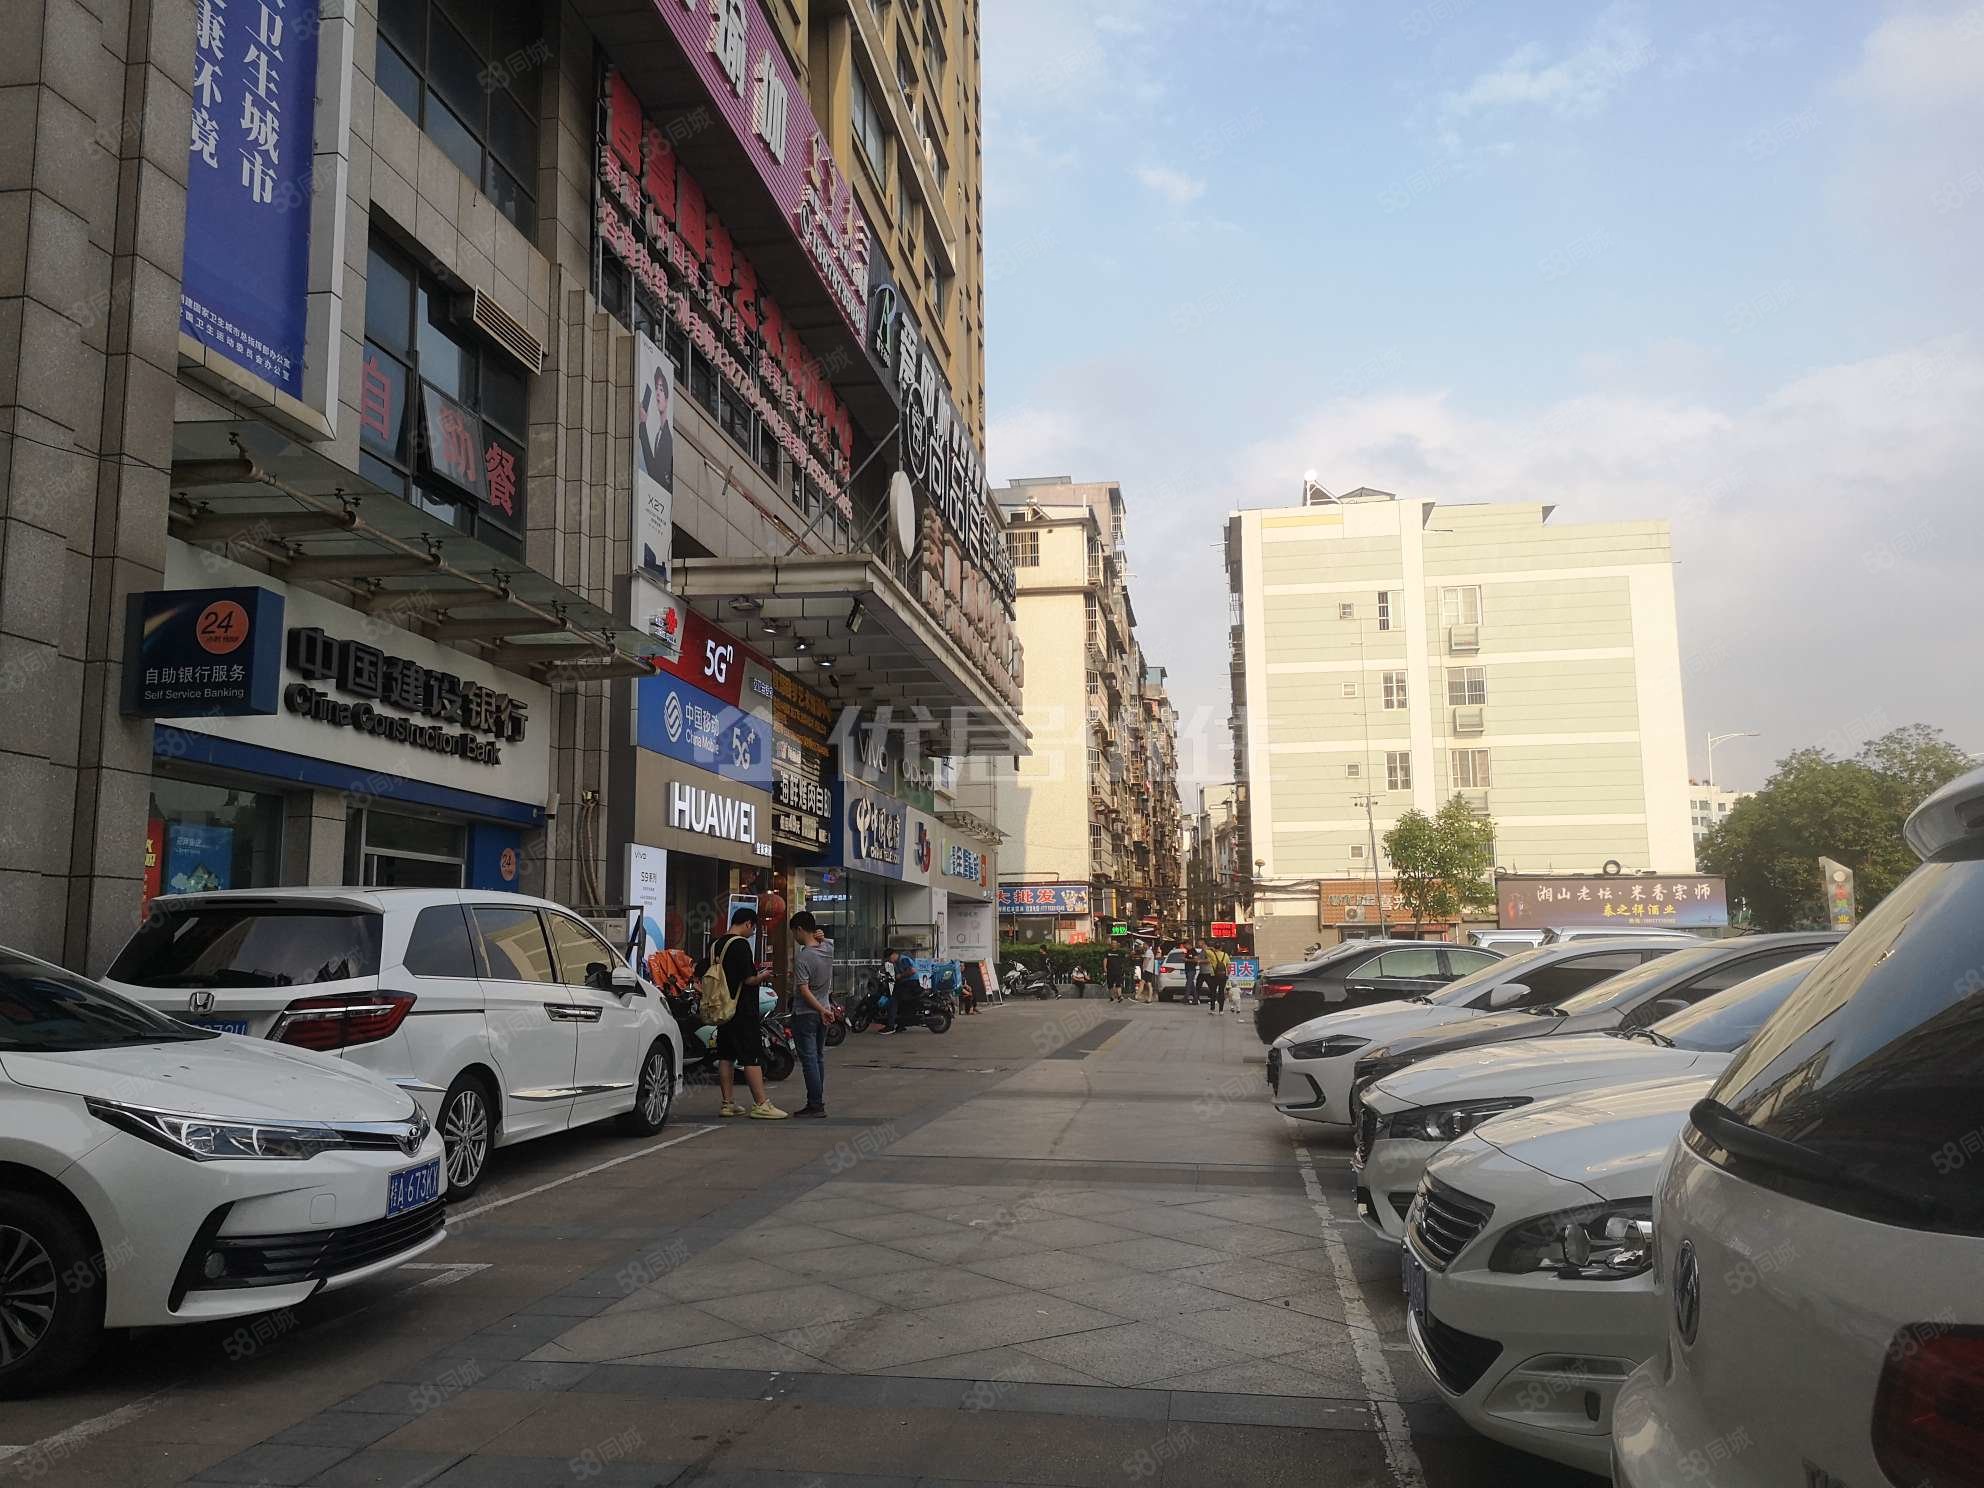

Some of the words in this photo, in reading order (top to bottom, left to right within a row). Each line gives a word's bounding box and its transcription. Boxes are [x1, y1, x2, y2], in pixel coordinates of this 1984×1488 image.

[240, 0, 287, 204] 卫生城市
[684, 0, 788, 166] 瑜伽
[200, 610, 234, 634] 24
[144, 663, 246, 685] 自助银行服务
[144, 689, 164, 700] Self
[165, 687, 202, 700] Service
[204, 686, 245, 700] Banking
[290, 627, 529, 742] 中国建设银行
[284, 682, 352, 727] China
[351, 701, 461, 756] Construction
[460, 733, 502, 766] Bank
[685, 701, 720, 738] 中国移动
[858, 730, 889, 774] vivo
[669, 781, 756, 844] HUAWEI
[870, 802, 900, 851] 中国电信
[501, 854, 512, 868] 24
